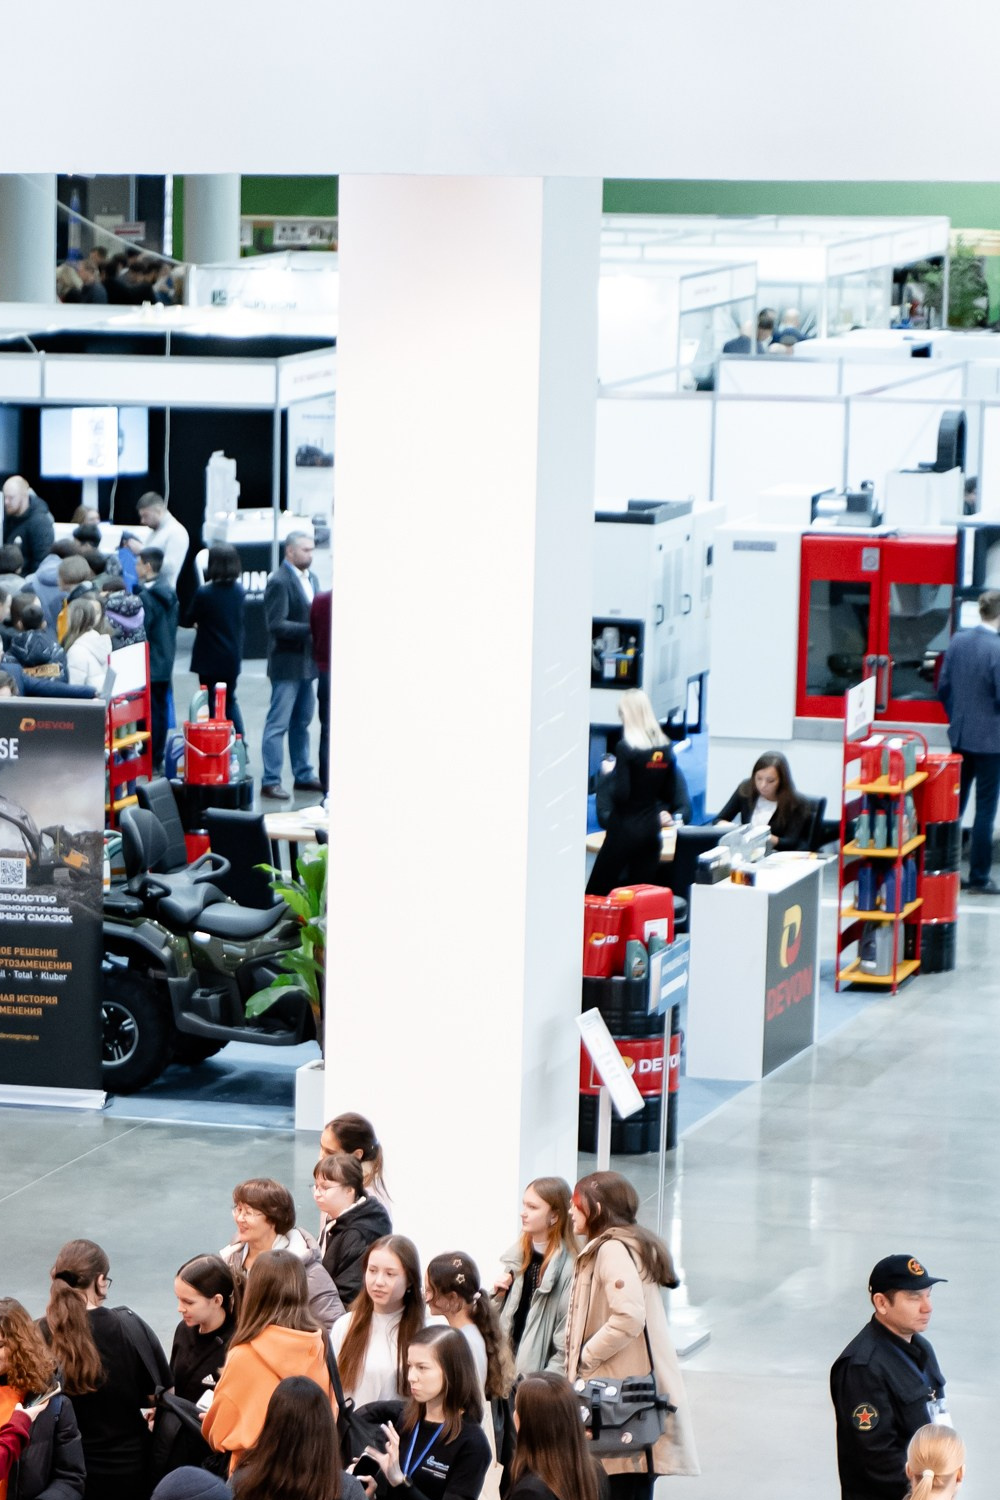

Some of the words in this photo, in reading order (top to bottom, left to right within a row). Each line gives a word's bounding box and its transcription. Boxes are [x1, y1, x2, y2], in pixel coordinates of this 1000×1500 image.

[36, 720, 75, 730] DEVON
[26, 913, 74, 924] СМАЗОК
[14, 946, 59, 958] РЕШЕНИЕ
[13, 970, 33, 980] Total
[40, 971, 68, 982] Kluber
[766, 965, 813, 1021] DEVON
[16, 994, 58, 1005] ИСТОРИЯ
